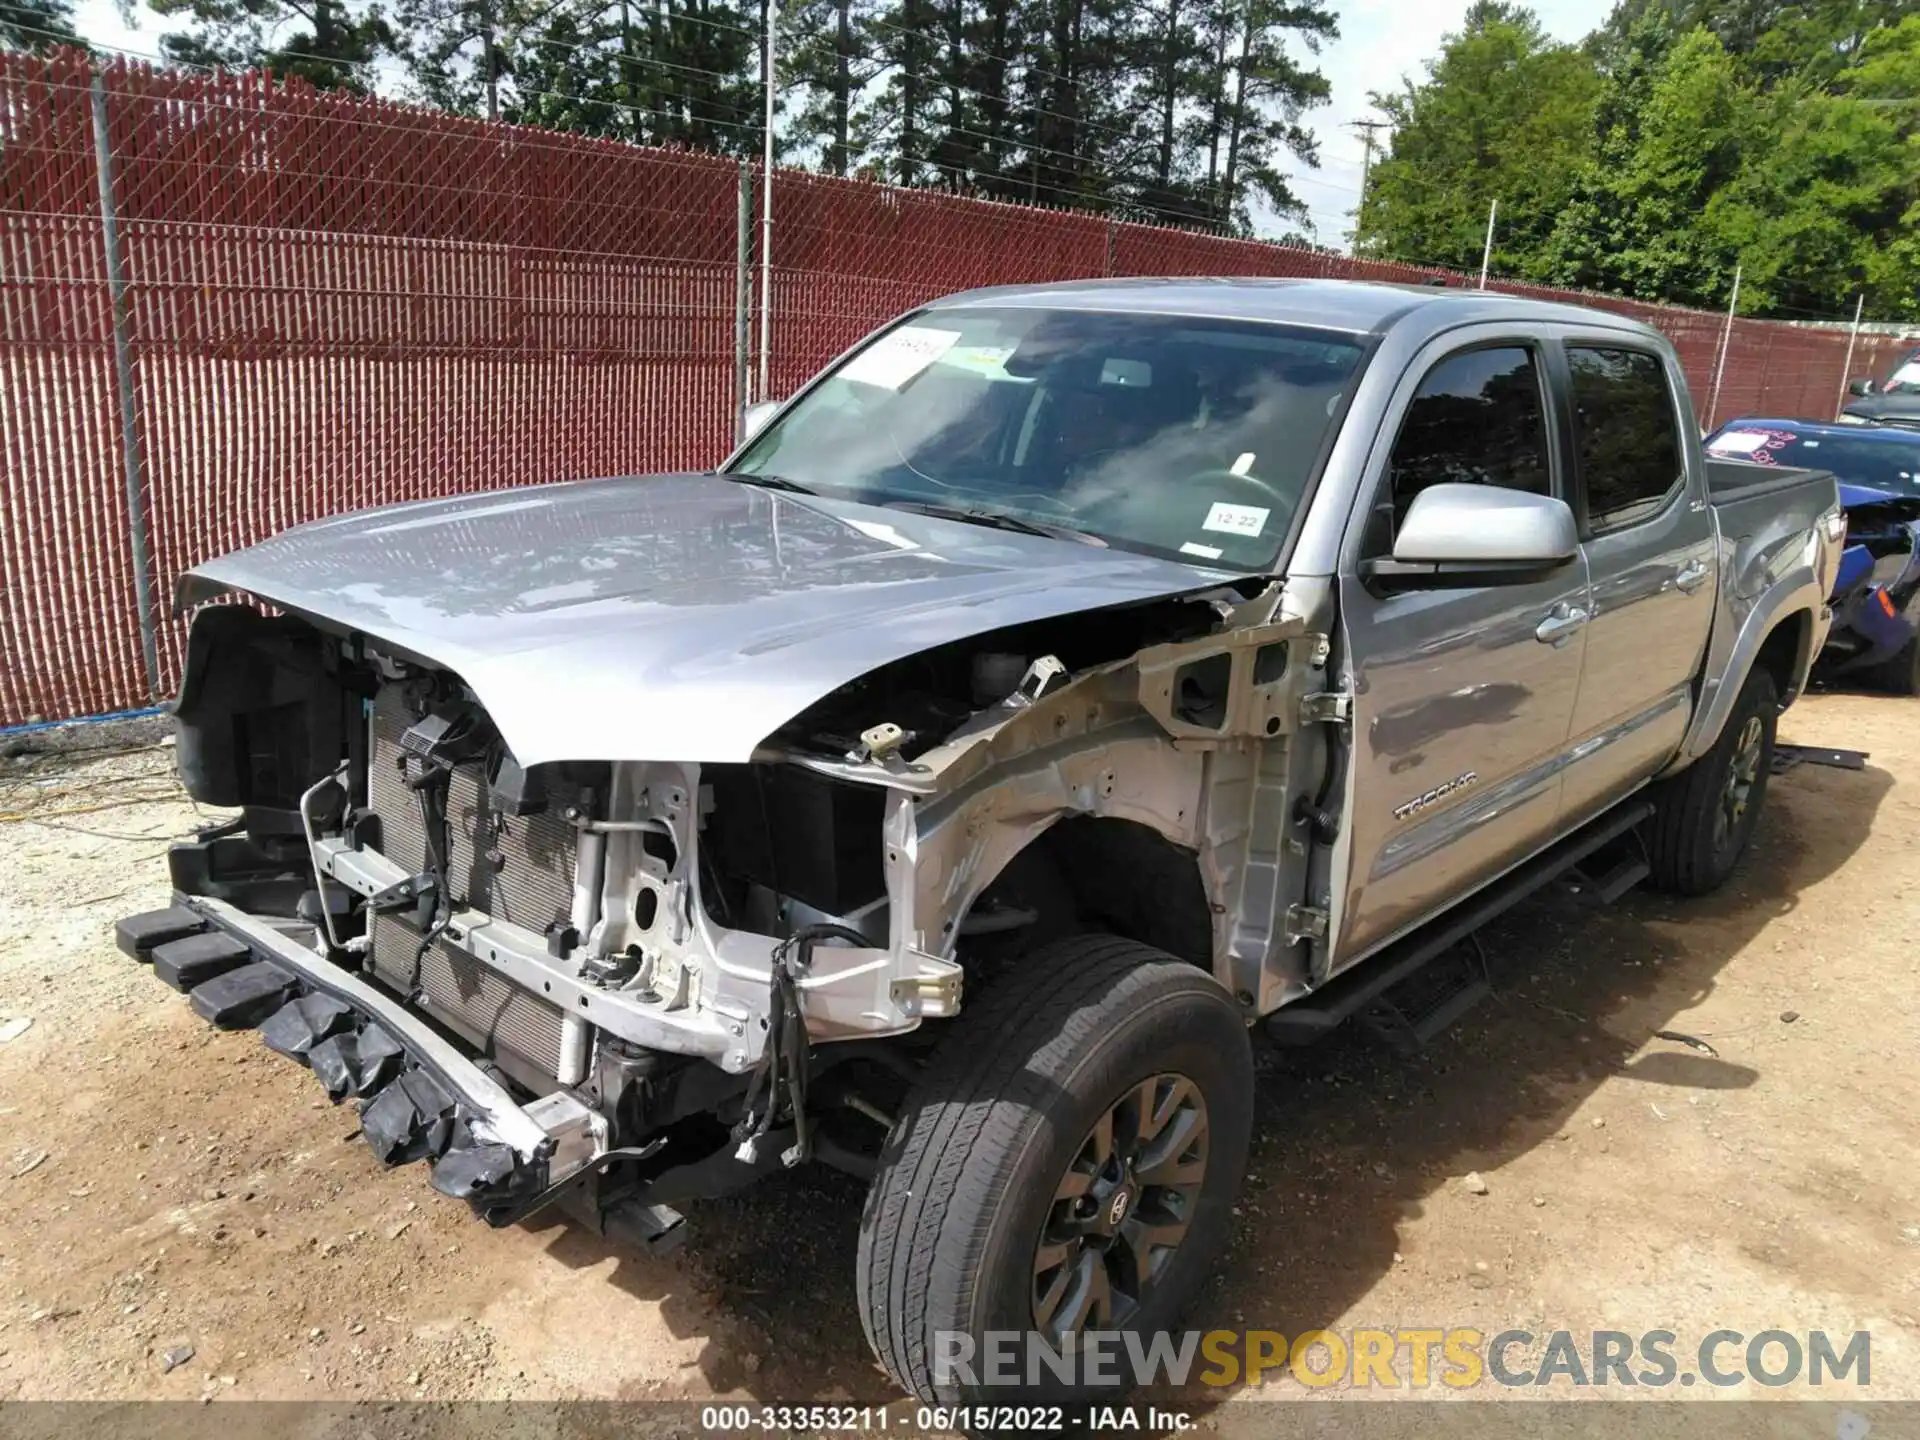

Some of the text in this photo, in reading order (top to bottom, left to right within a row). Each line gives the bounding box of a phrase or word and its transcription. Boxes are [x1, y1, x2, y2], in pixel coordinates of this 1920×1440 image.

[1217, 513, 1258, 527] 12 22
[1393, 771, 1477, 820] TACOMA
